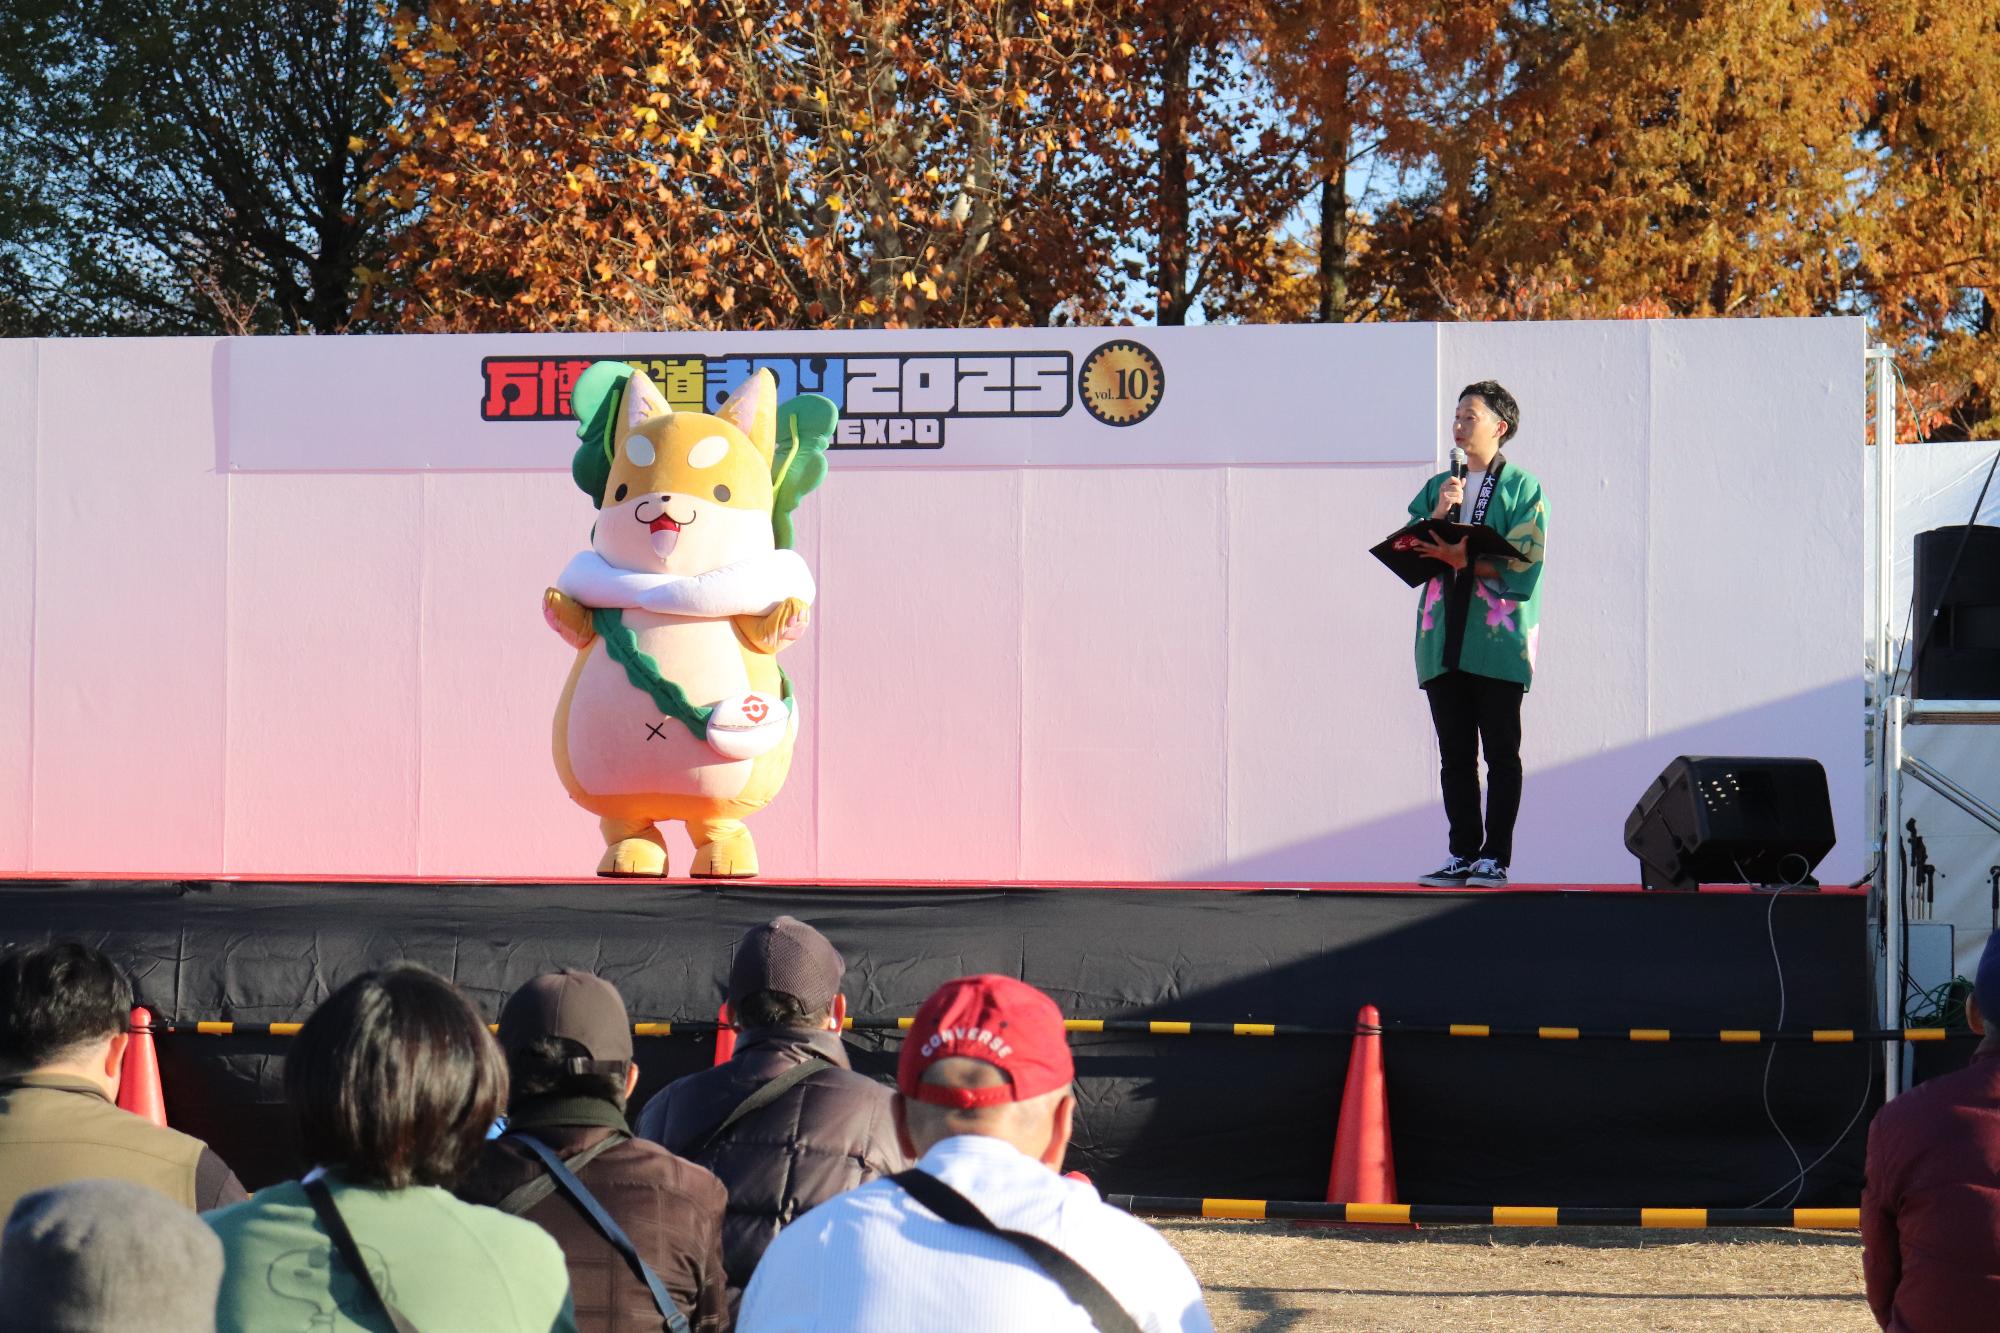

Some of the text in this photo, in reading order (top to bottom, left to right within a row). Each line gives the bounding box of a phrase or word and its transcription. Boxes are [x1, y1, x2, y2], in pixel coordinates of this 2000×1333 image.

[1095, 368, 1148, 400] vol.10
[1473, 474, 1495, 525] 大阪府守
[921, 1026, 1013, 1058] CONVERSE
